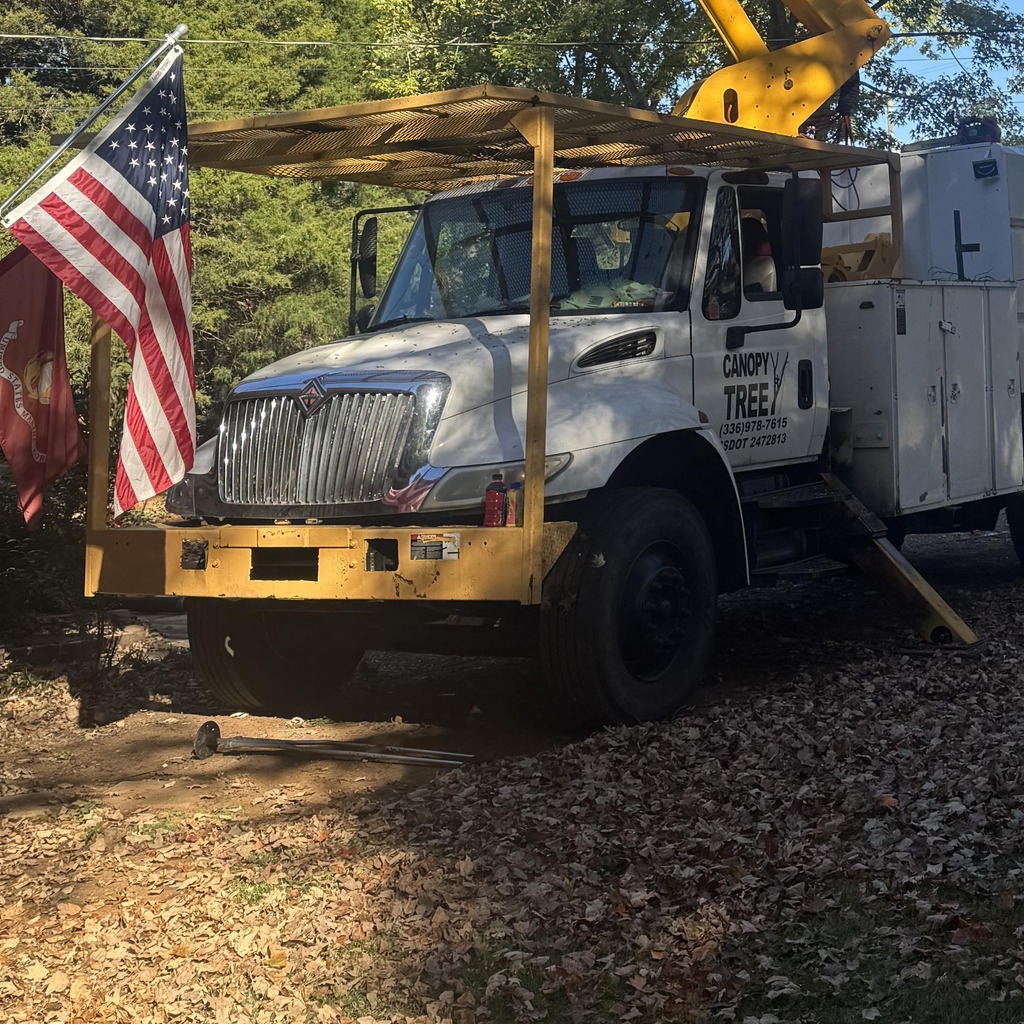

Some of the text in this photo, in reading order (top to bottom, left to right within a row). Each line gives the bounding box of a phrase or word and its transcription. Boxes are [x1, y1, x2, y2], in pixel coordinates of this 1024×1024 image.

[723, 352, 770, 379] CANOPY
[723, 382, 769, 421] TREE
[719, 417, 788, 438] (336)978-7615
[721, 432, 787, 452] SDOT 2472813
